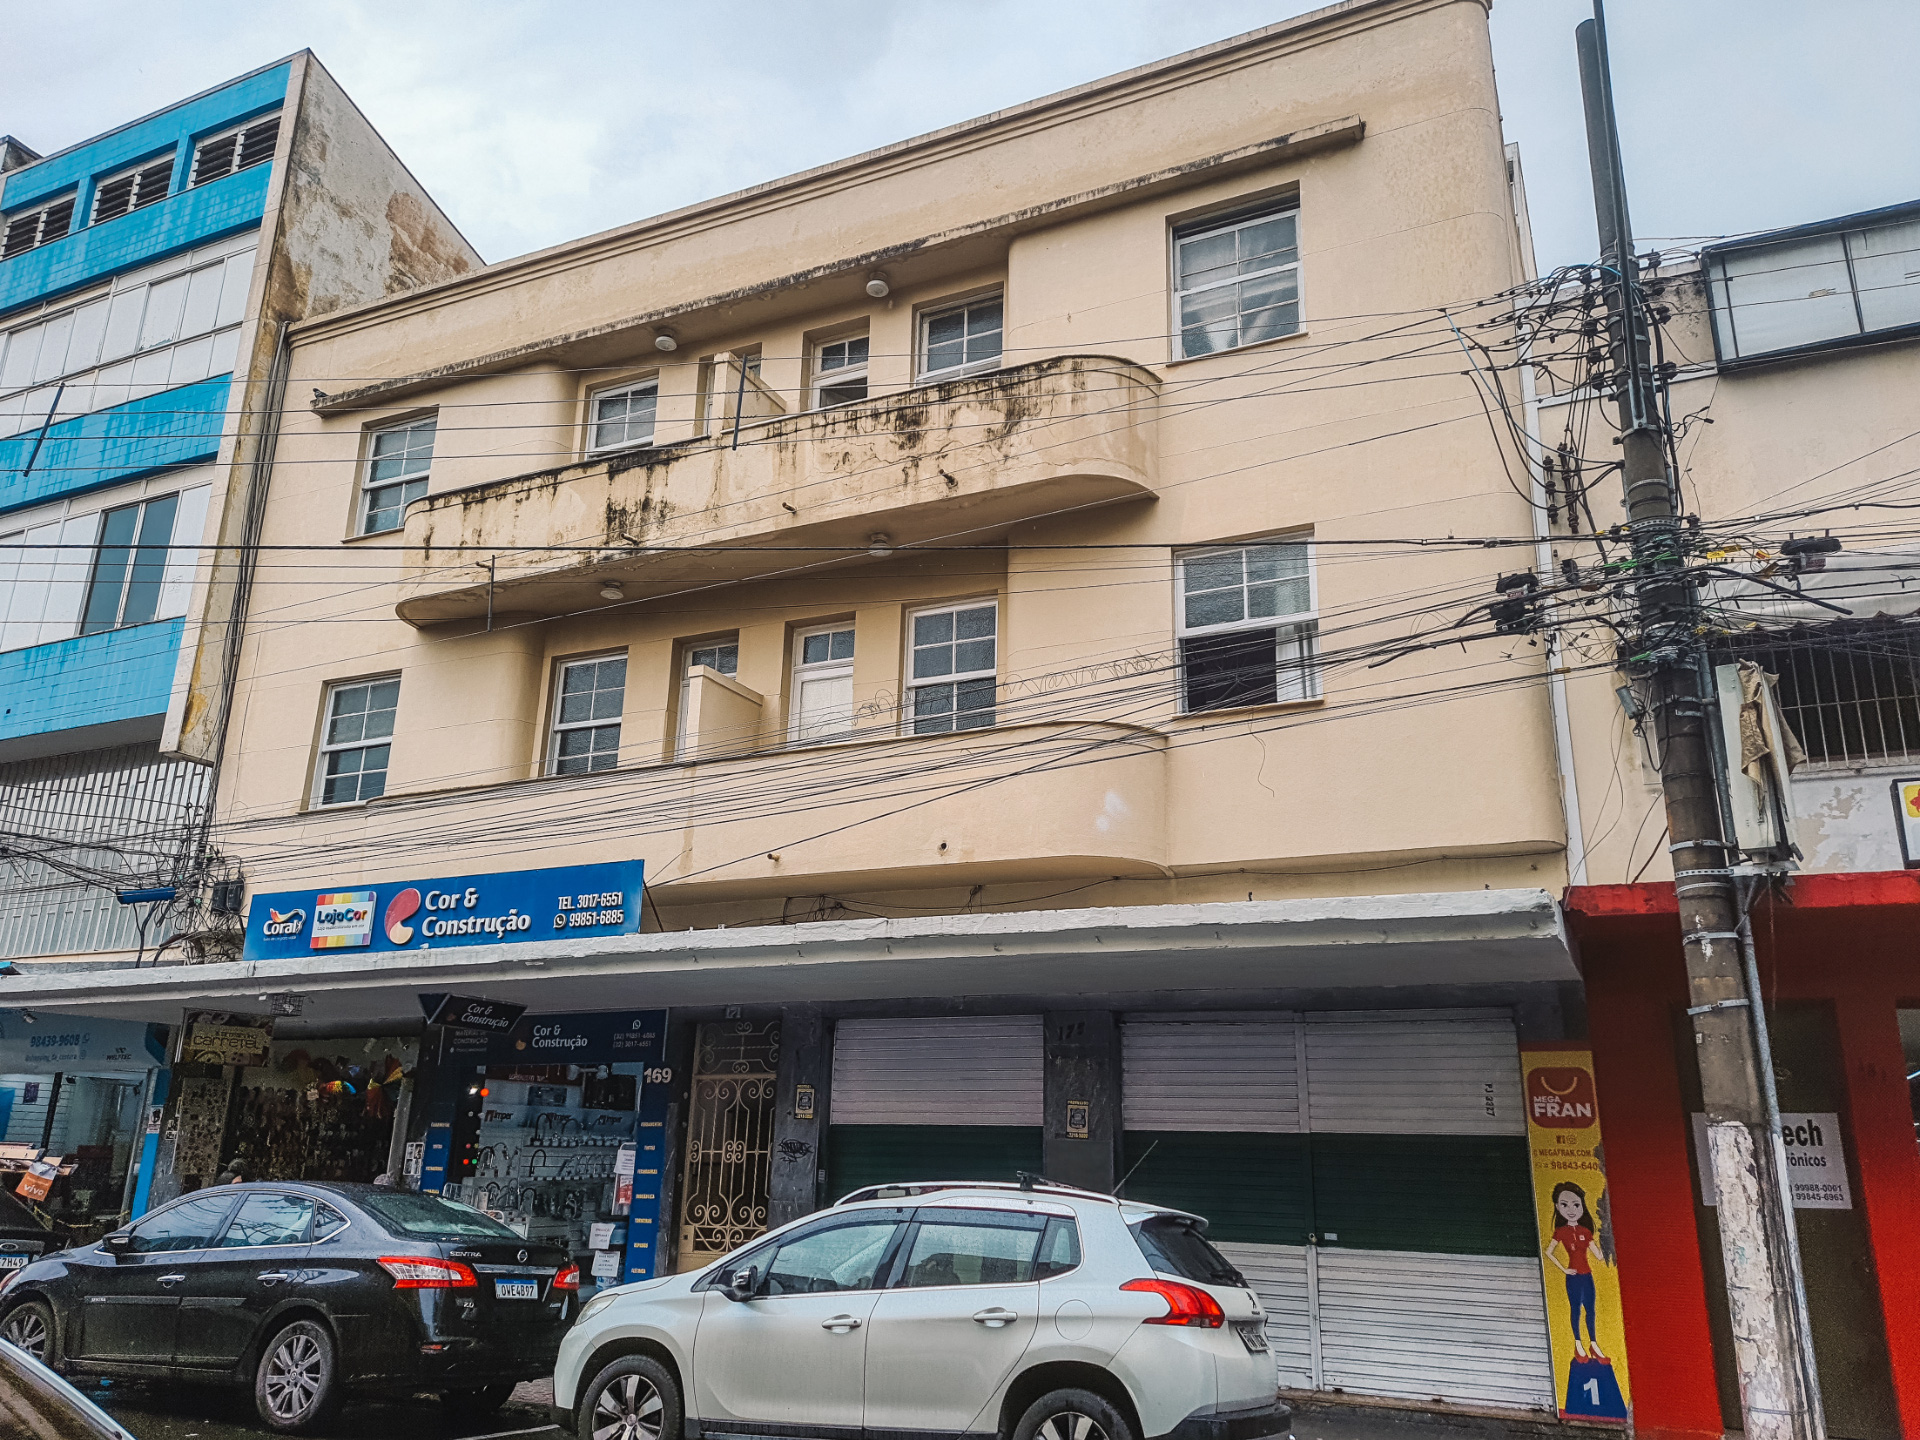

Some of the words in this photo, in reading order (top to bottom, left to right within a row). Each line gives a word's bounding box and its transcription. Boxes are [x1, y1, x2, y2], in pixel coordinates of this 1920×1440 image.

[424, 889, 461, 911] Cor
[463, 886, 479, 908] &
[557, 895, 575, 910] TEL.
[576, 890, 623, 909] 3017-6551
[317, 907, 368, 925] LojaCor
[421, 908, 532, 939] Construção
[568, 909, 625, 927] 99851-6885
[263, 919, 298, 936] Coral
[467, 1003, 484, 1014] Cor
[484, 1005, 493, 1014] &
[461, 1012, 509, 1029] Construção
[533, 1024, 552, 1036] Cor
[553, 1024, 561, 1035] &
[30, 1033, 80, 1048] 98439-9608
[532, 1034, 588, 1050] Construção
[643, 1066, 673, 1084] 169
[1485, 1095, 1496, 1117] 3327
[1533, 1095, 1562, 1103] MEGA
[1534, 1102, 1593, 1118] FRAN
[1782, 1118, 1824, 1147] ech
[1786, 1152, 1827, 1167] rônicos
[23, 1183, 45, 1196] vivo
[449, 1250, 482, 1258] SENTRA
[0, 1257, 24, 1268] 7H49
[501, 1284, 535, 1297] OVE4B97
